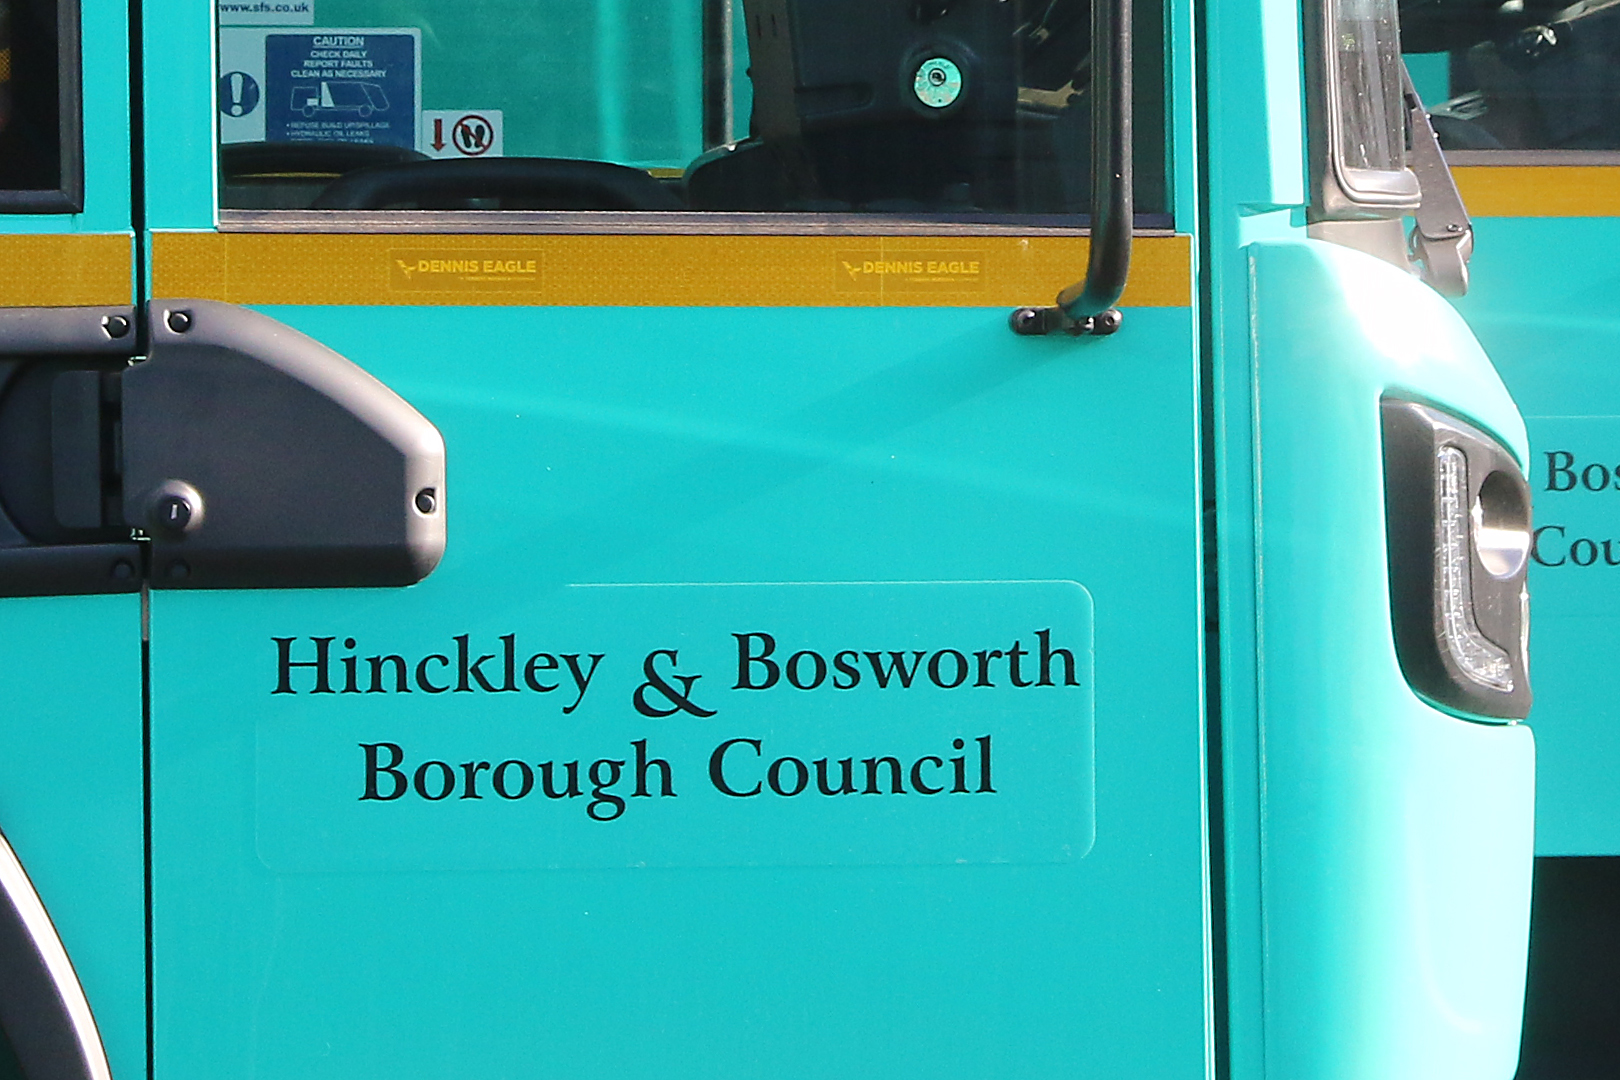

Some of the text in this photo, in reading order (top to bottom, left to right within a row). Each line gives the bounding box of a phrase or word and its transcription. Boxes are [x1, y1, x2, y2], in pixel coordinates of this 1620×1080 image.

[219, 2, 309, 13] www.sfs.co.uk
[313, 36, 364, 46] CAUTION
[310, 50, 368, 58] CHECK DAILY
[303, 60, 374, 68] REPORT FAULTS
[290, 70, 387, 78] CLEAN AS NECESSARY
[418, 260, 537, 273] DENNIS EAGLE
[862, 261, 980, 274] DENNIS EAGLE
[270, 629, 1081, 718] Hinckley & Bosworth
[358, 735, 998, 822] Borough Council
